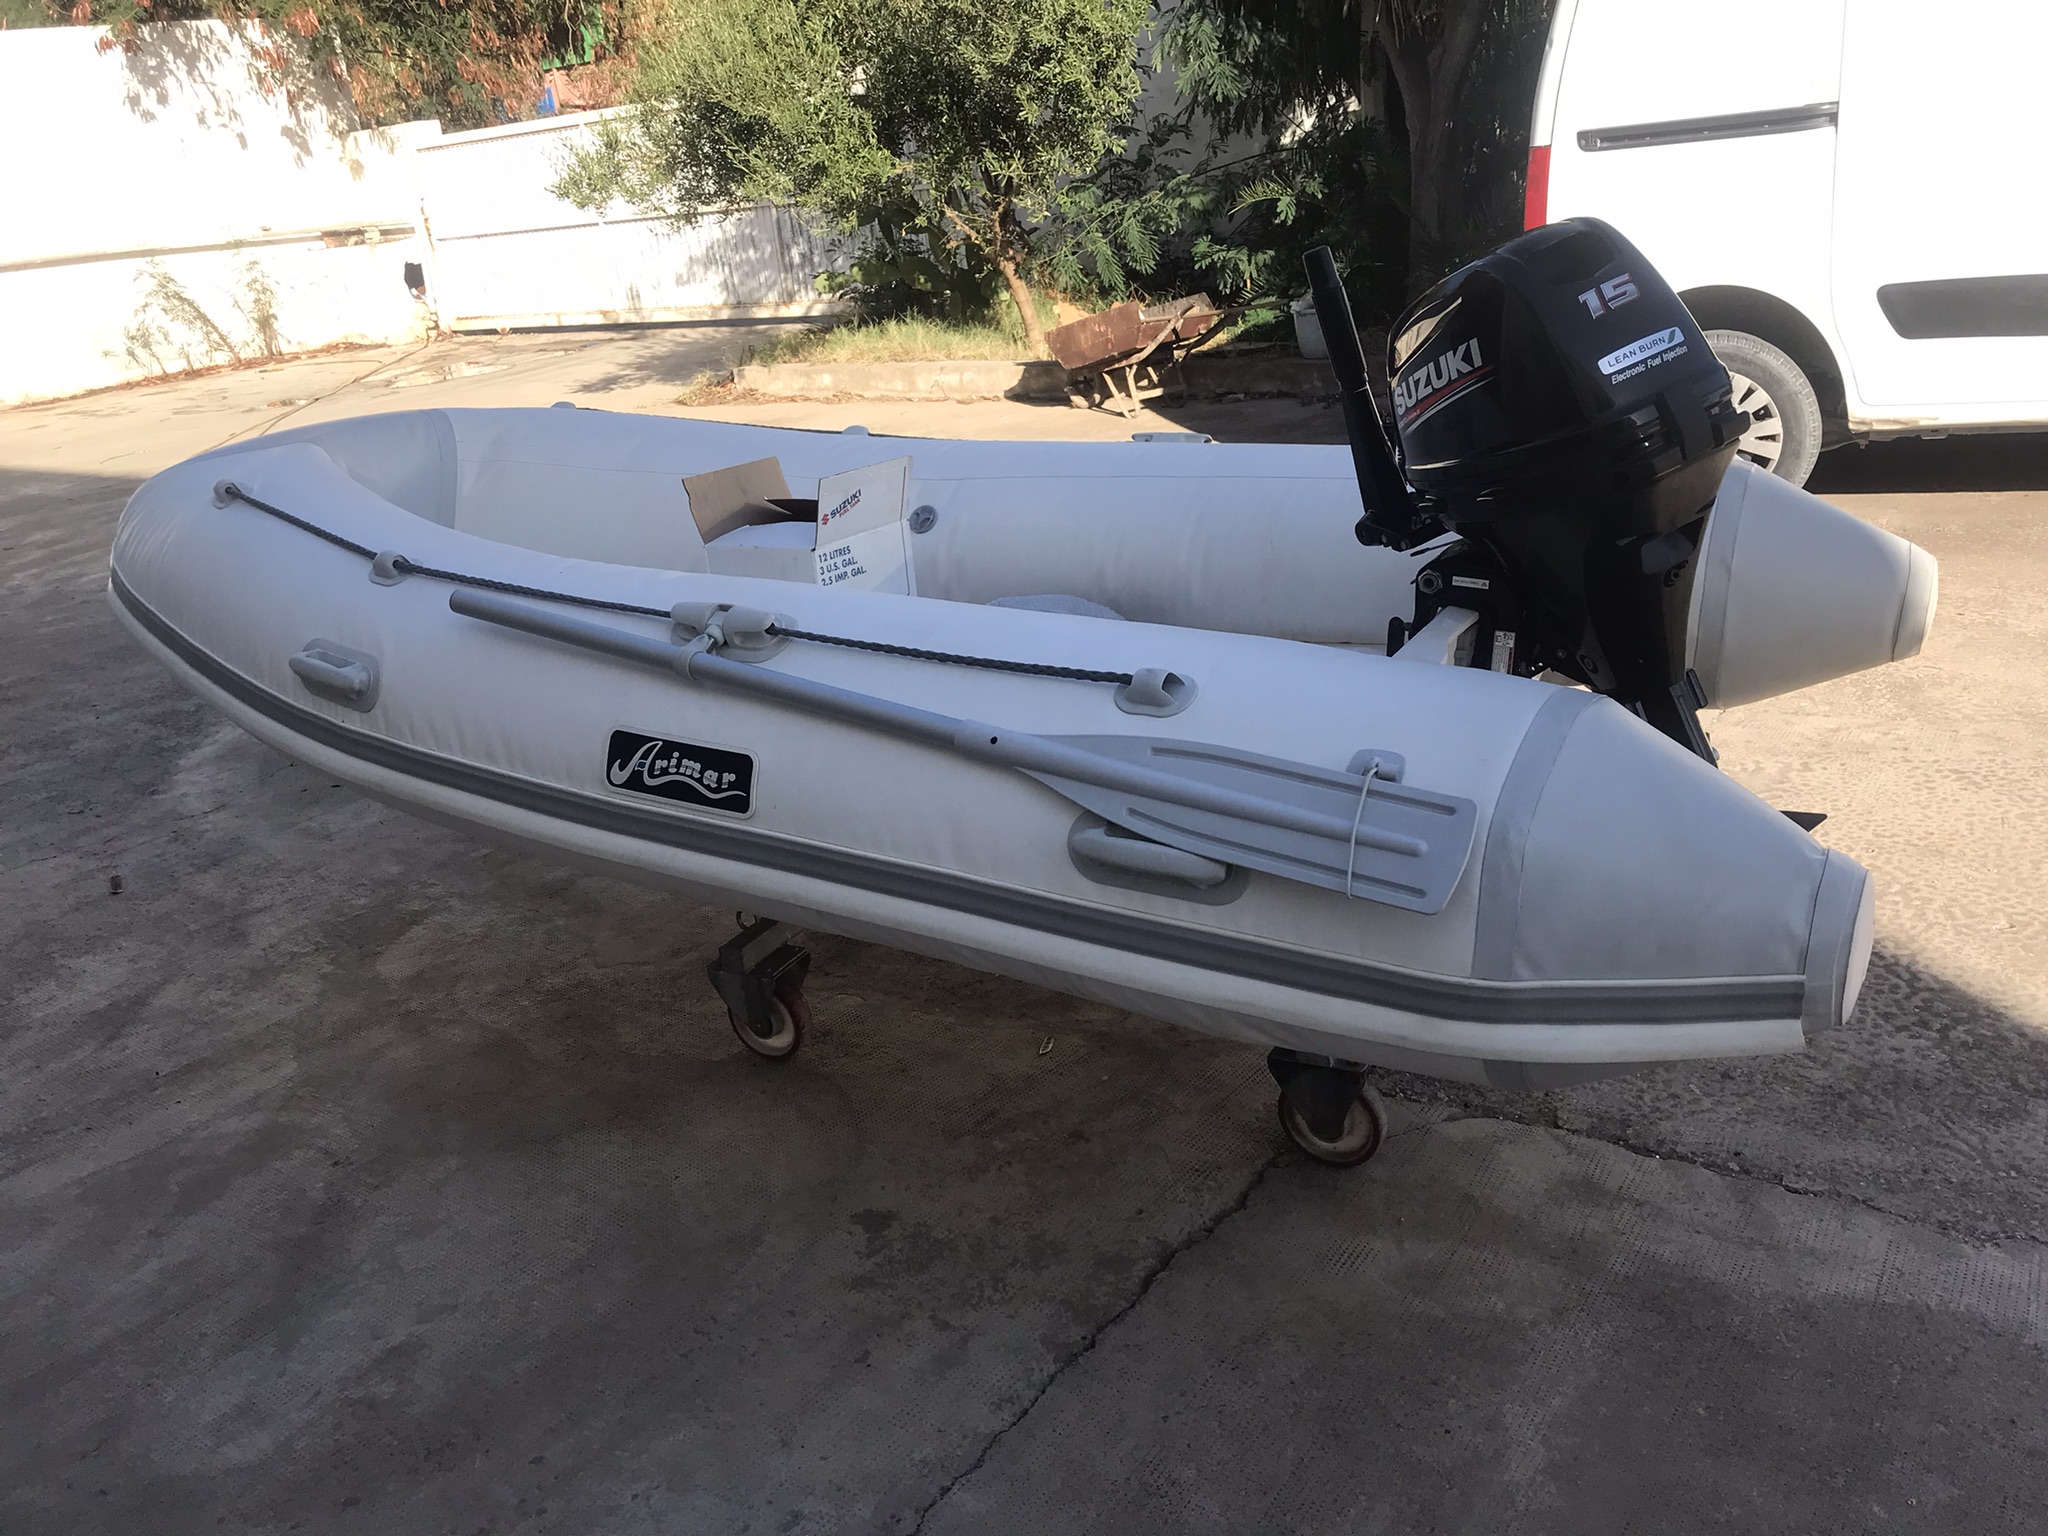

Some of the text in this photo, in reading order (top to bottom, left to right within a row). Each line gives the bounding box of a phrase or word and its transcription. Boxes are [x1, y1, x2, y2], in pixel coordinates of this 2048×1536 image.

[1578, 273, 1640, 319] 15
[1608, 336, 1666, 367] LEAN BURN
[1611, 346, 1688, 384] Electronic Fuel Injection
[1395, 337, 1482, 415] SUZUKI
[830, 489, 861, 519] SUZUKI
[819, 545, 851, 563] 12 LITRES
[820, 557, 858, 575] 3 U.S. GAL.
[821, 566, 867, 586] 2.5 IMP. GAL.
[610, 741, 744, 797] Arimar
